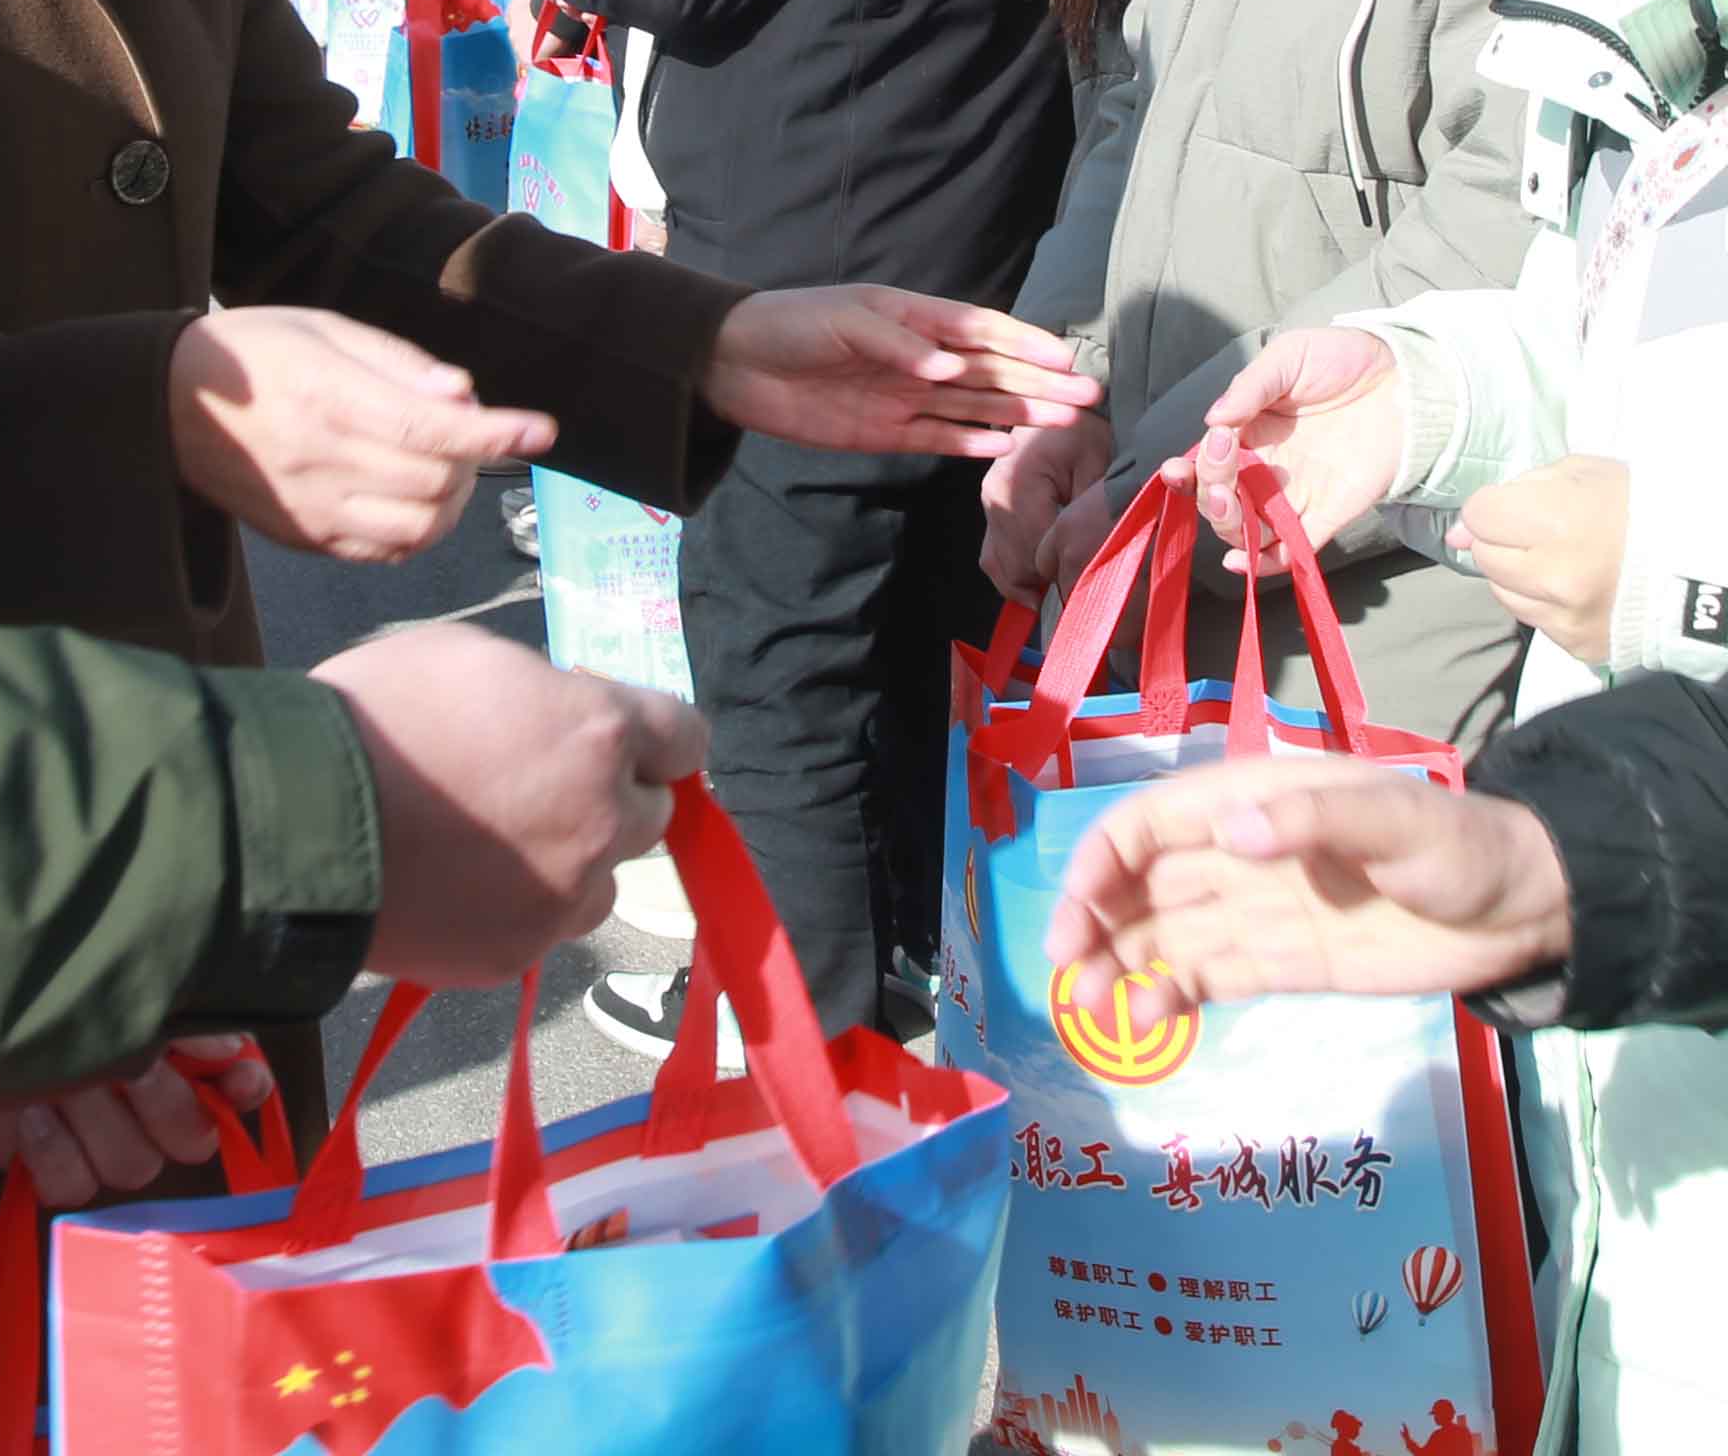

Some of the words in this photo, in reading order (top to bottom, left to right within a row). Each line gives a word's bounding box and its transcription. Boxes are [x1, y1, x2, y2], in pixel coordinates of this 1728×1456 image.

[1010, 1120, 1126, 1189] 职工
[1151, 1128, 1392, 1208] 真诚服务
[1048, 1255, 1138, 1288] 尊重职工
[1178, 1276, 1278, 1302] 理解职工
[1054, 1298, 1144, 1331] 保护职工
[1184, 1320, 1283, 1347] 爱护职工
